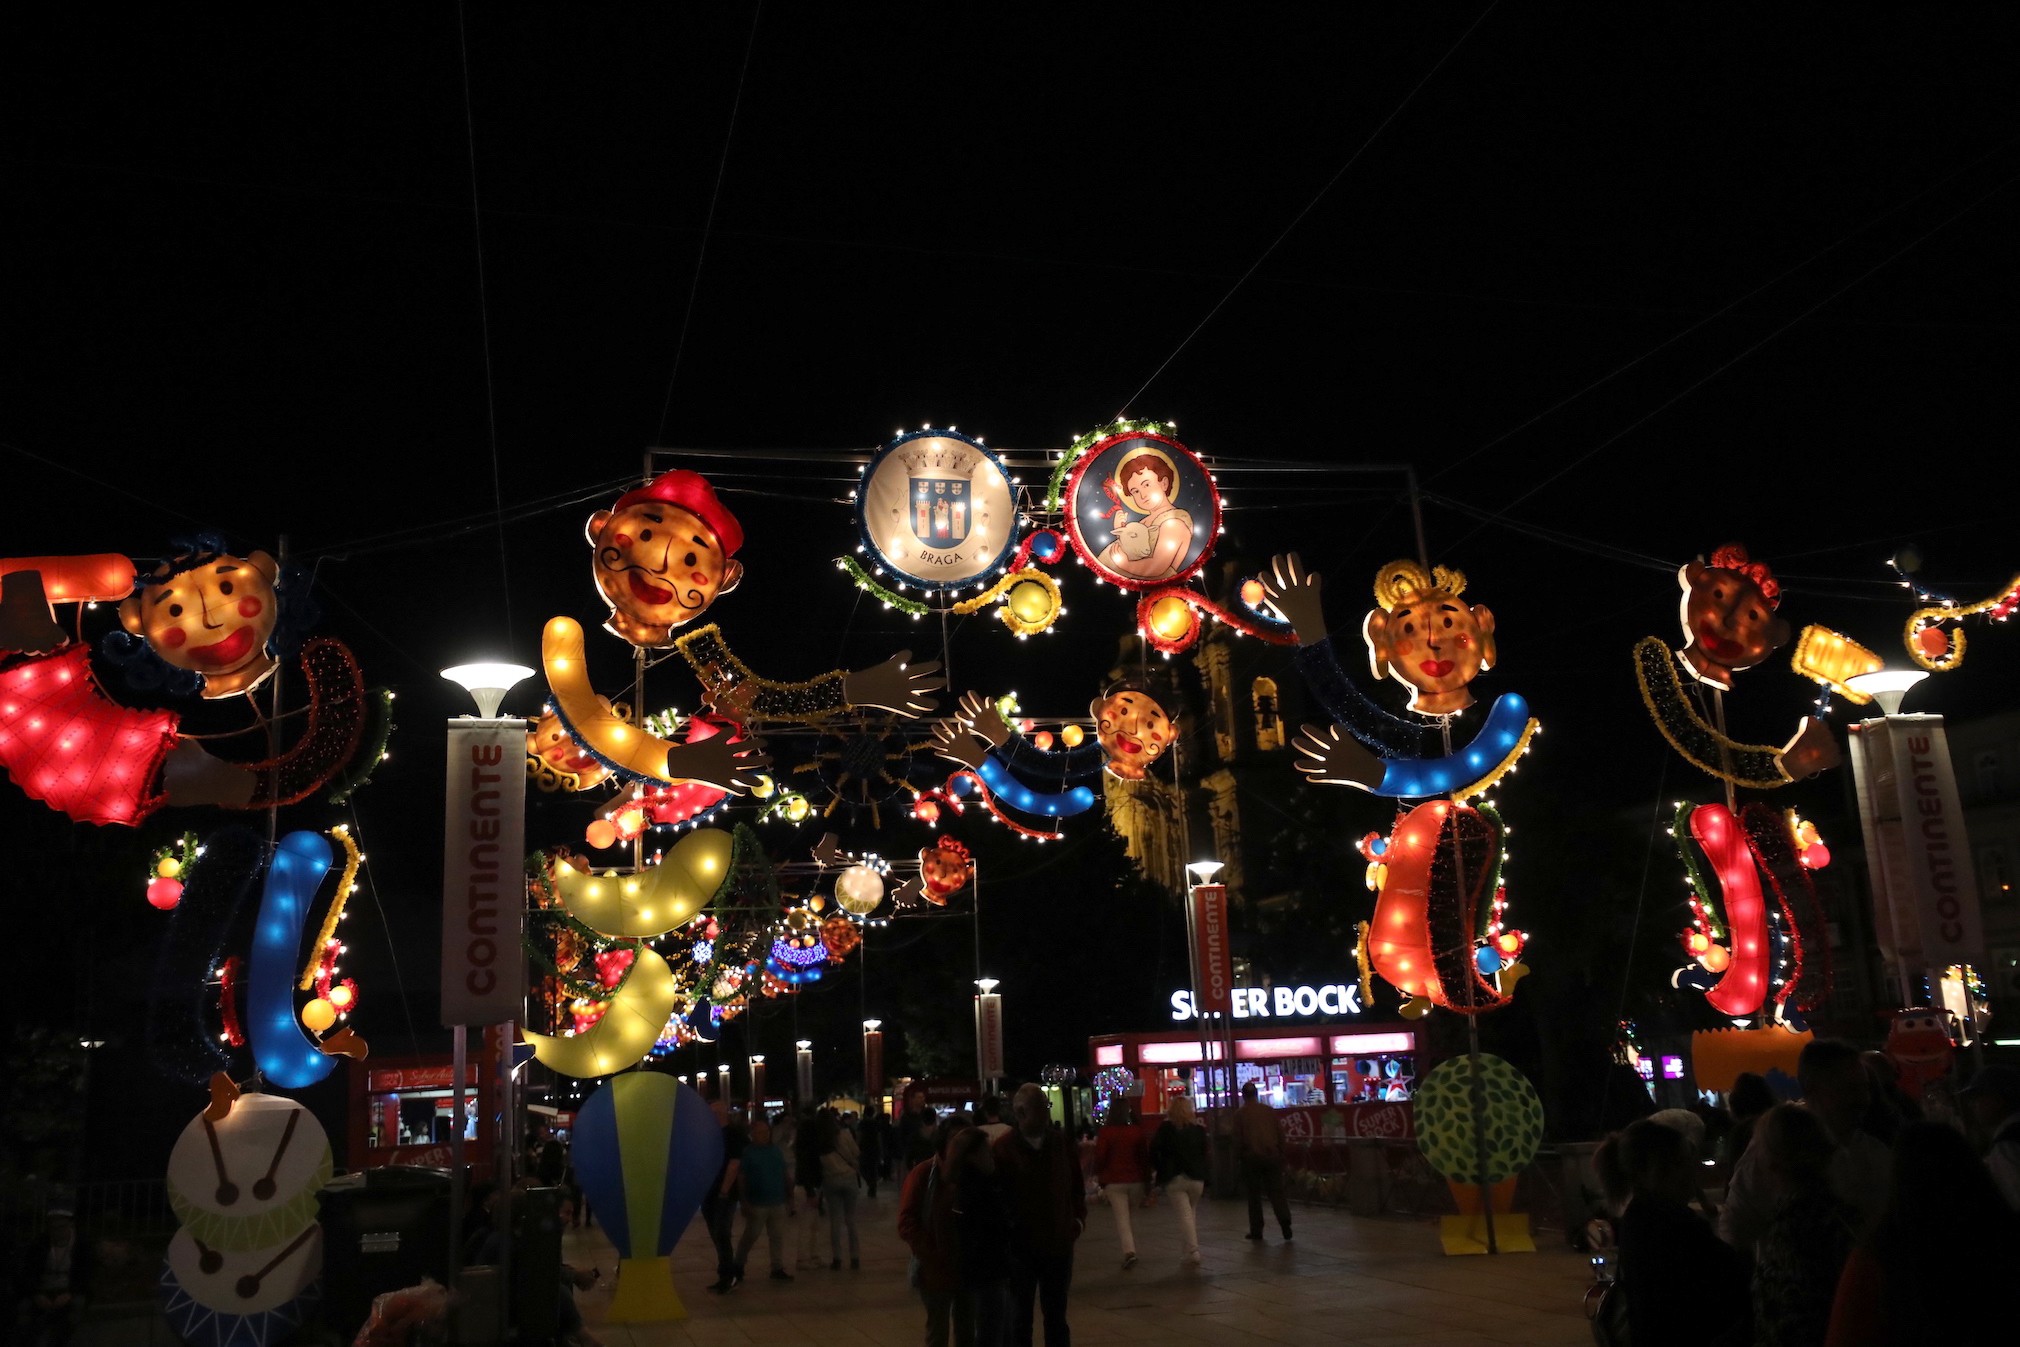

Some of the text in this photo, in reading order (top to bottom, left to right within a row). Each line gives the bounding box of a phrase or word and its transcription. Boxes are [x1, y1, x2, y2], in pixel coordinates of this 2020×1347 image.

[920, 551, 963, 565] BRAGA
[466, 744, 502, 996] CONTINENTE
[1908, 733, 1963, 944] CONTINENTE
[1205, 891, 1224, 1000] CONTINENTE
[1170, 984, 1361, 1021] SER BOCK
[1359, 1106, 1397, 1133] SUPER
